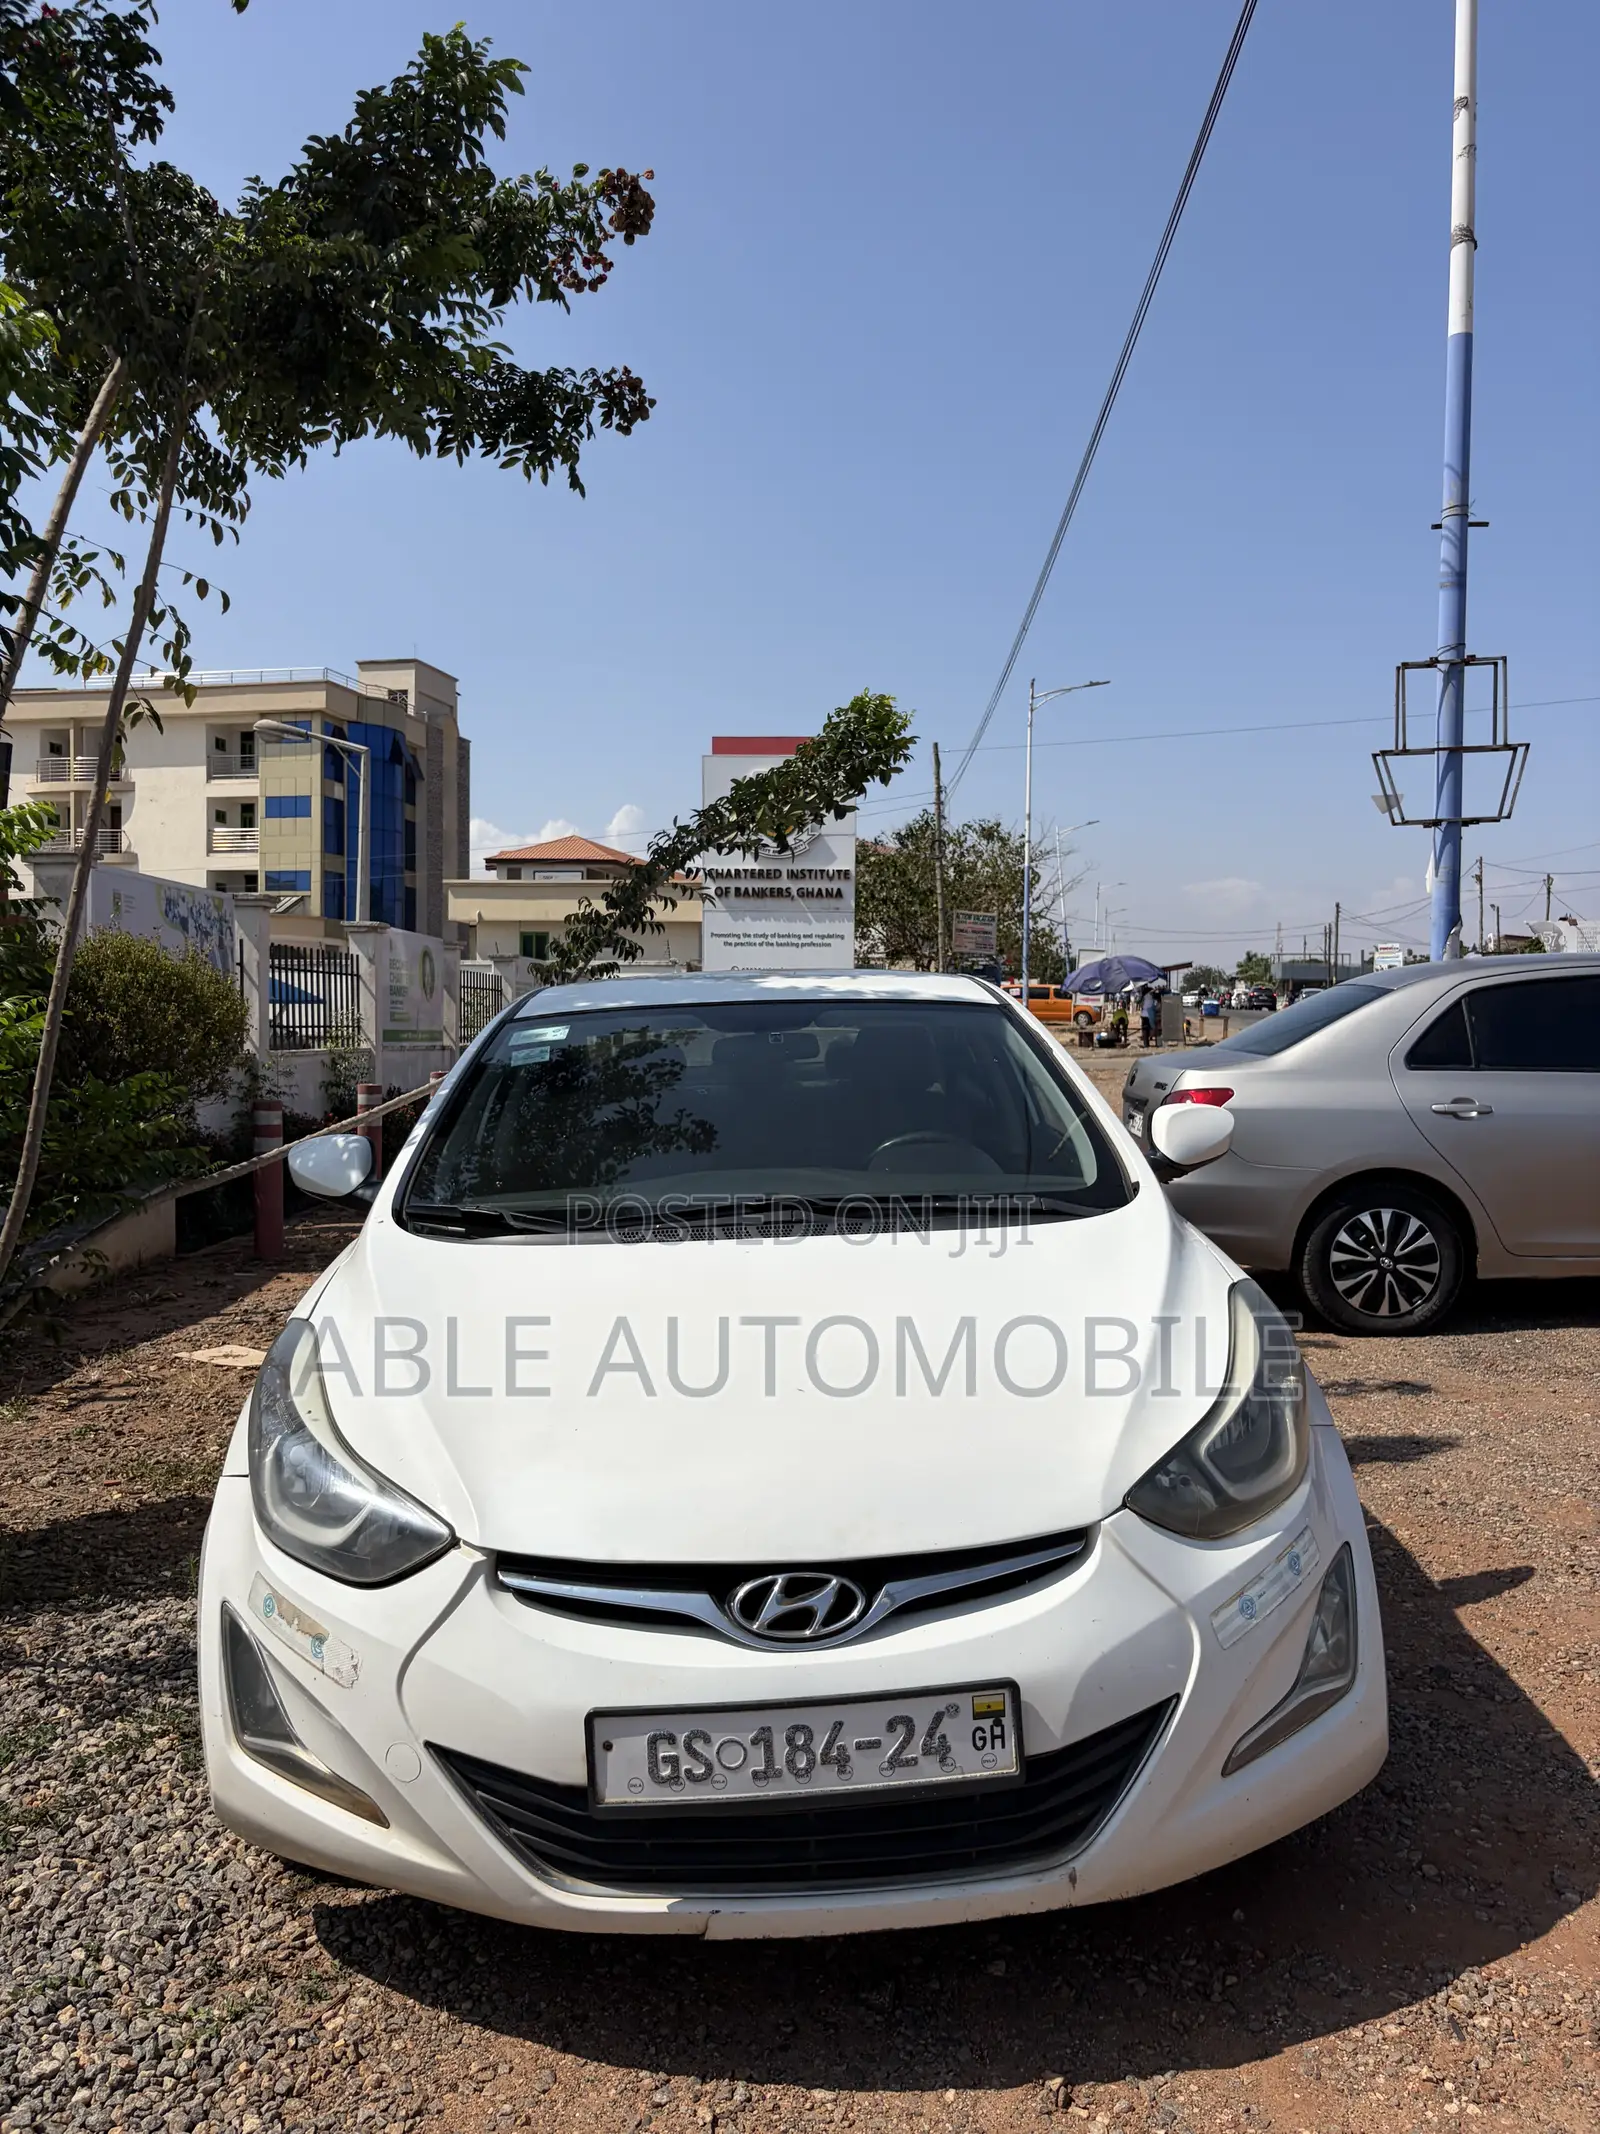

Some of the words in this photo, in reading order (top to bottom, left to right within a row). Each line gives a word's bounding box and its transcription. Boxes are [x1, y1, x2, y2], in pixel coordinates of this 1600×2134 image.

[708, 868, 782, 880] CHARTERED
[786, 868, 851, 881] INSTITUTE
[714, 886, 731, 898] OF
[734, 886, 795, 900] BANKERS,
[796, 887, 844, 899] GHANA
[710, 932, 741, 940] Promoting
[753, 932, 769, 940] study
[777, 932, 802, 941] banking
[814, 933, 845, 941] regulating
[734, 941, 757, 949] practice
[776, 941, 800, 949] banking
[800, 942, 832, 950] profession
[972, 1724, 1006, 1751] GH
[646, 1729, 714, 1783] GS
[749, 1710, 952, 1779] 184-24
